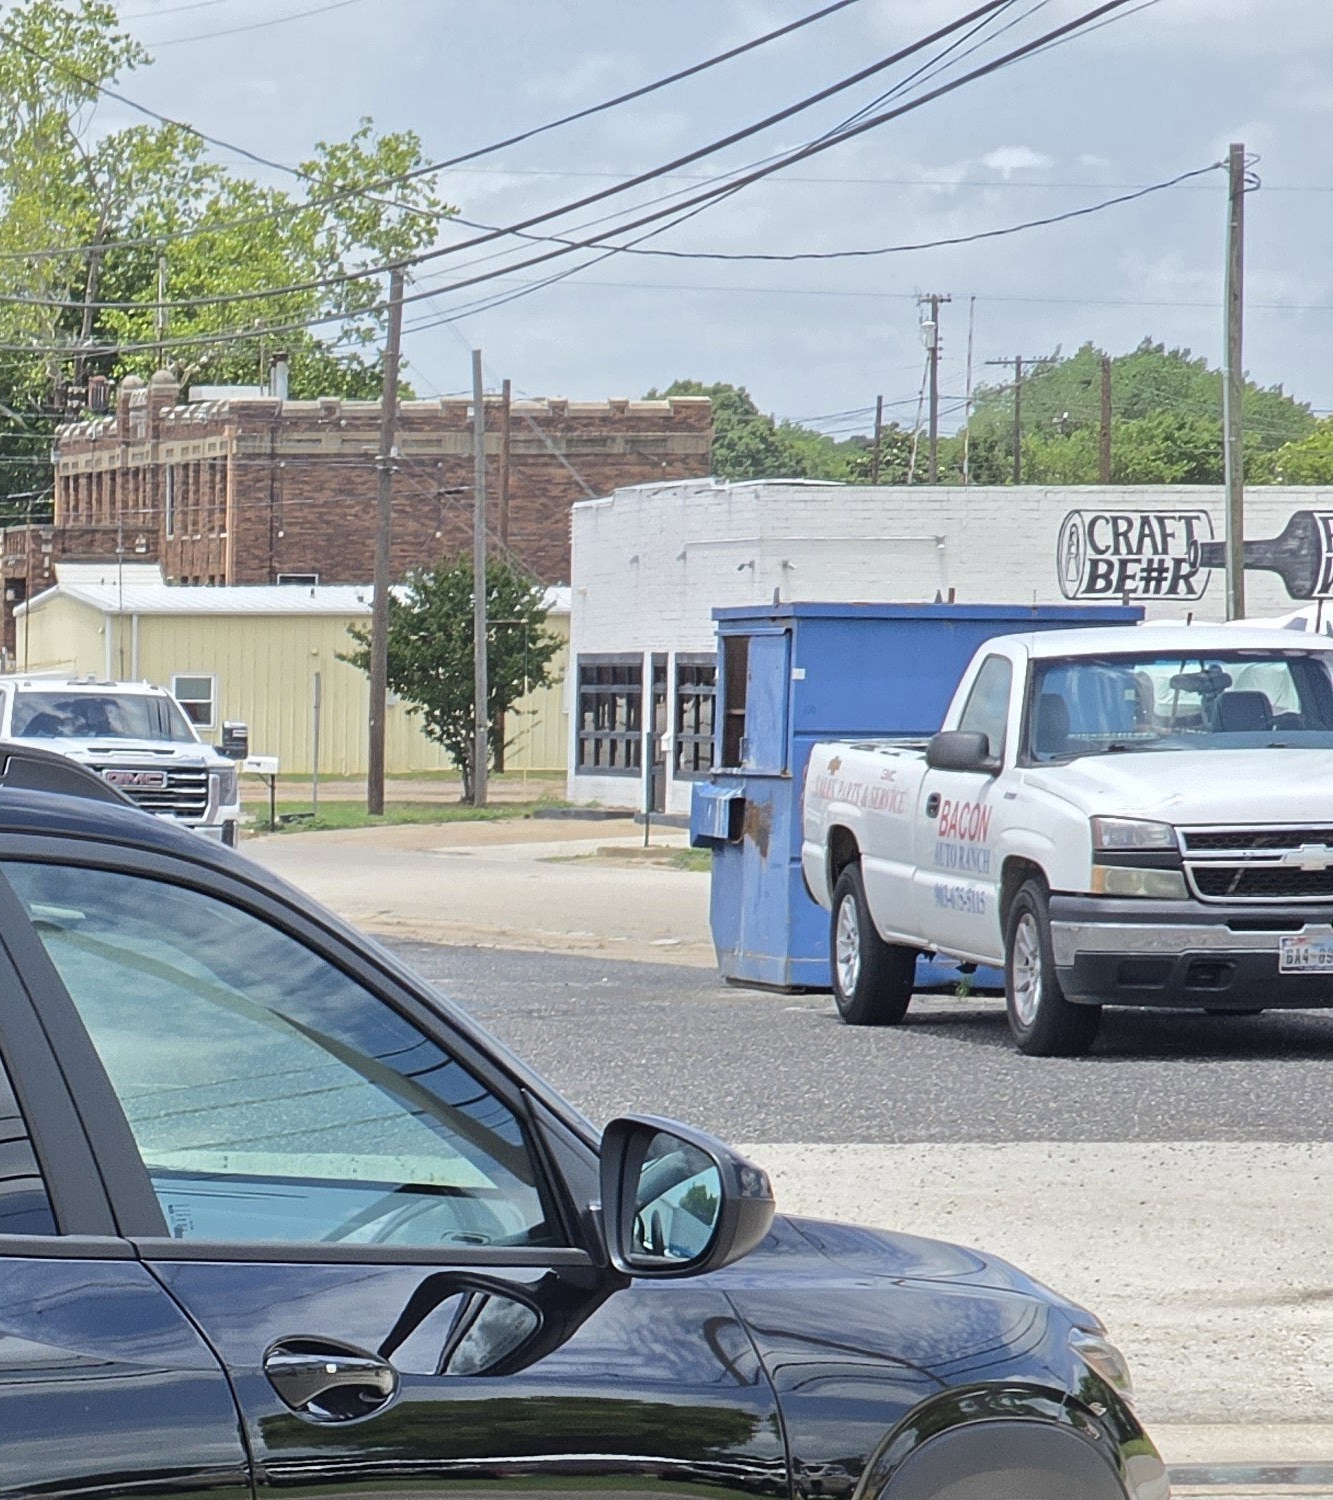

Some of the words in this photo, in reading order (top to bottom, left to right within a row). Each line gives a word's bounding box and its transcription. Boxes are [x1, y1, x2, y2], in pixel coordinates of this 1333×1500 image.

[1087, 514, 1201, 556] CRAFT
[106, 771, 164, 785] GMC
[938, 799, 993, 843] BACON
